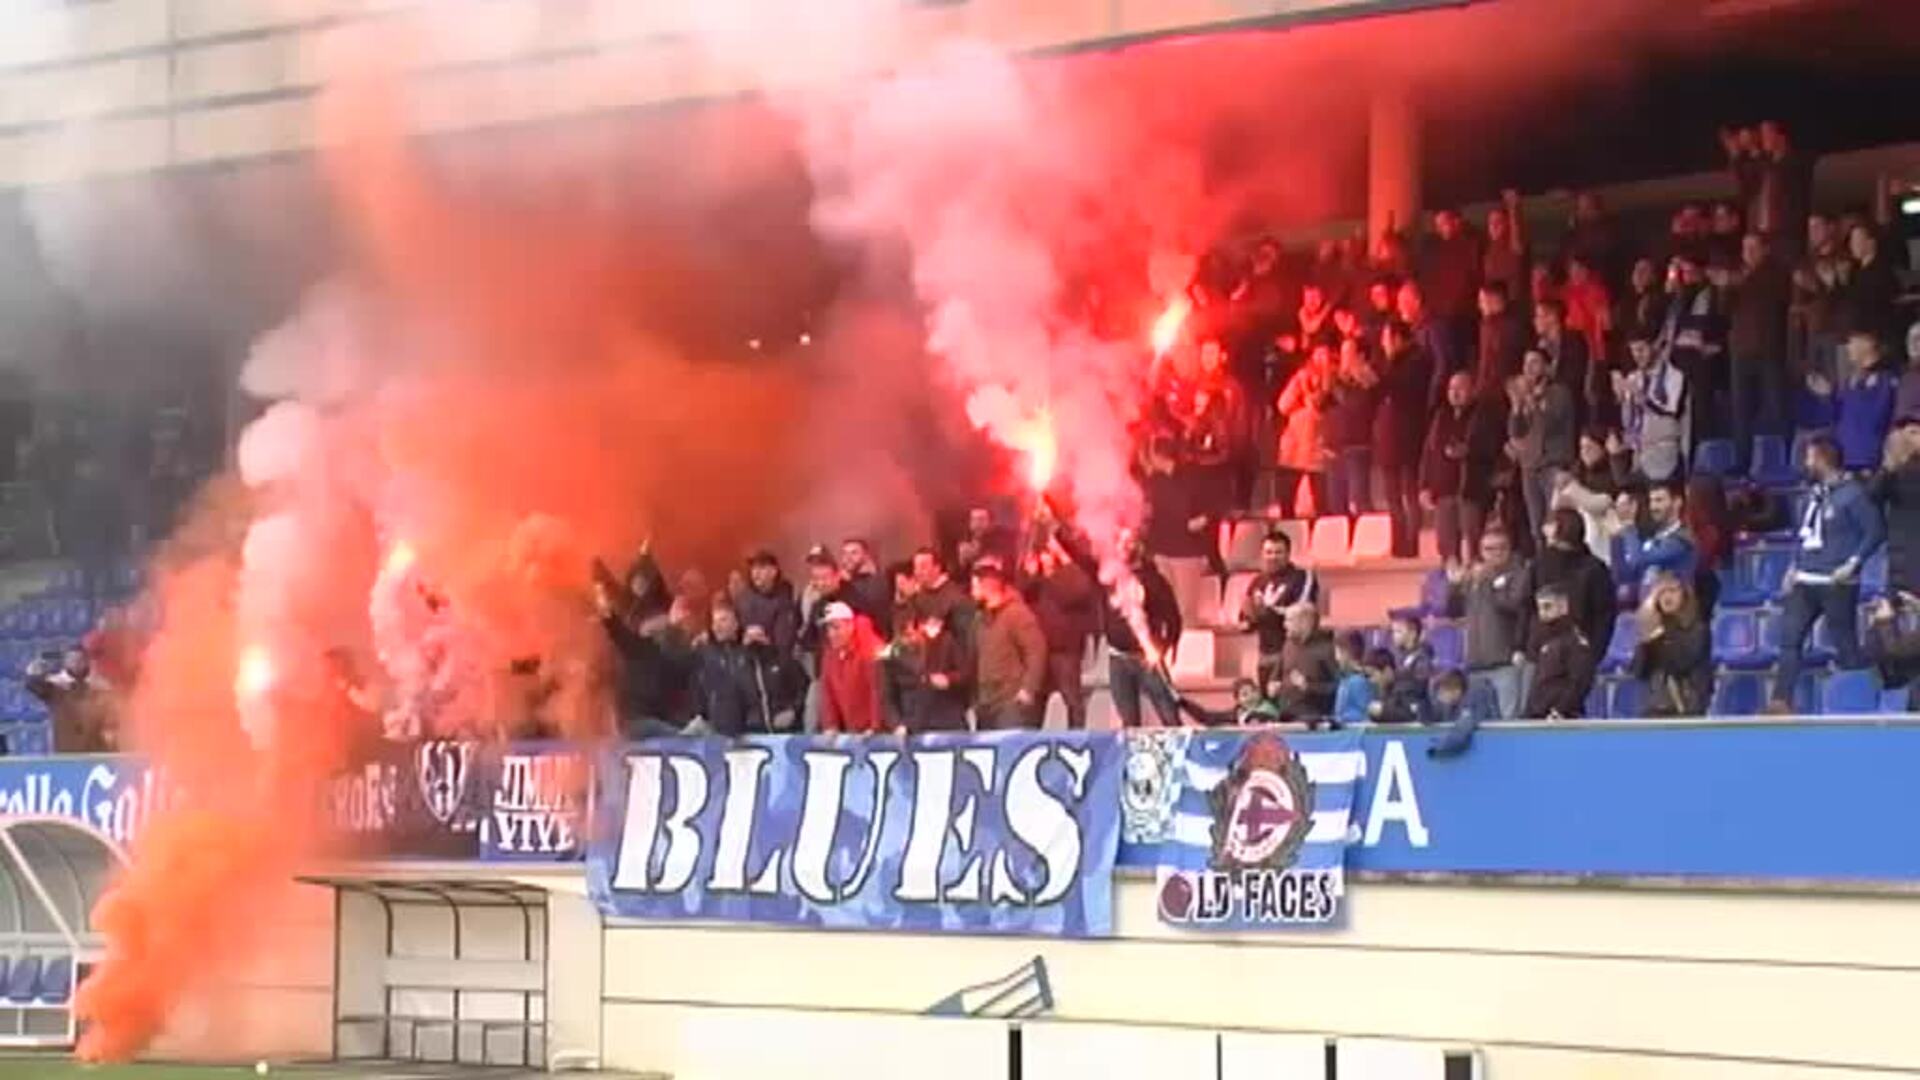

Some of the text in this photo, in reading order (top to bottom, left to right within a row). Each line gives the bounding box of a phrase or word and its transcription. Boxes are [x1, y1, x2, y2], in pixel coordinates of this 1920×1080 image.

[494, 811, 578, 852] VIVE
[612, 745, 1093, 904] BLUES
[1350, 739, 1429, 847] A
[1243, 871, 1335, 920] FACES
